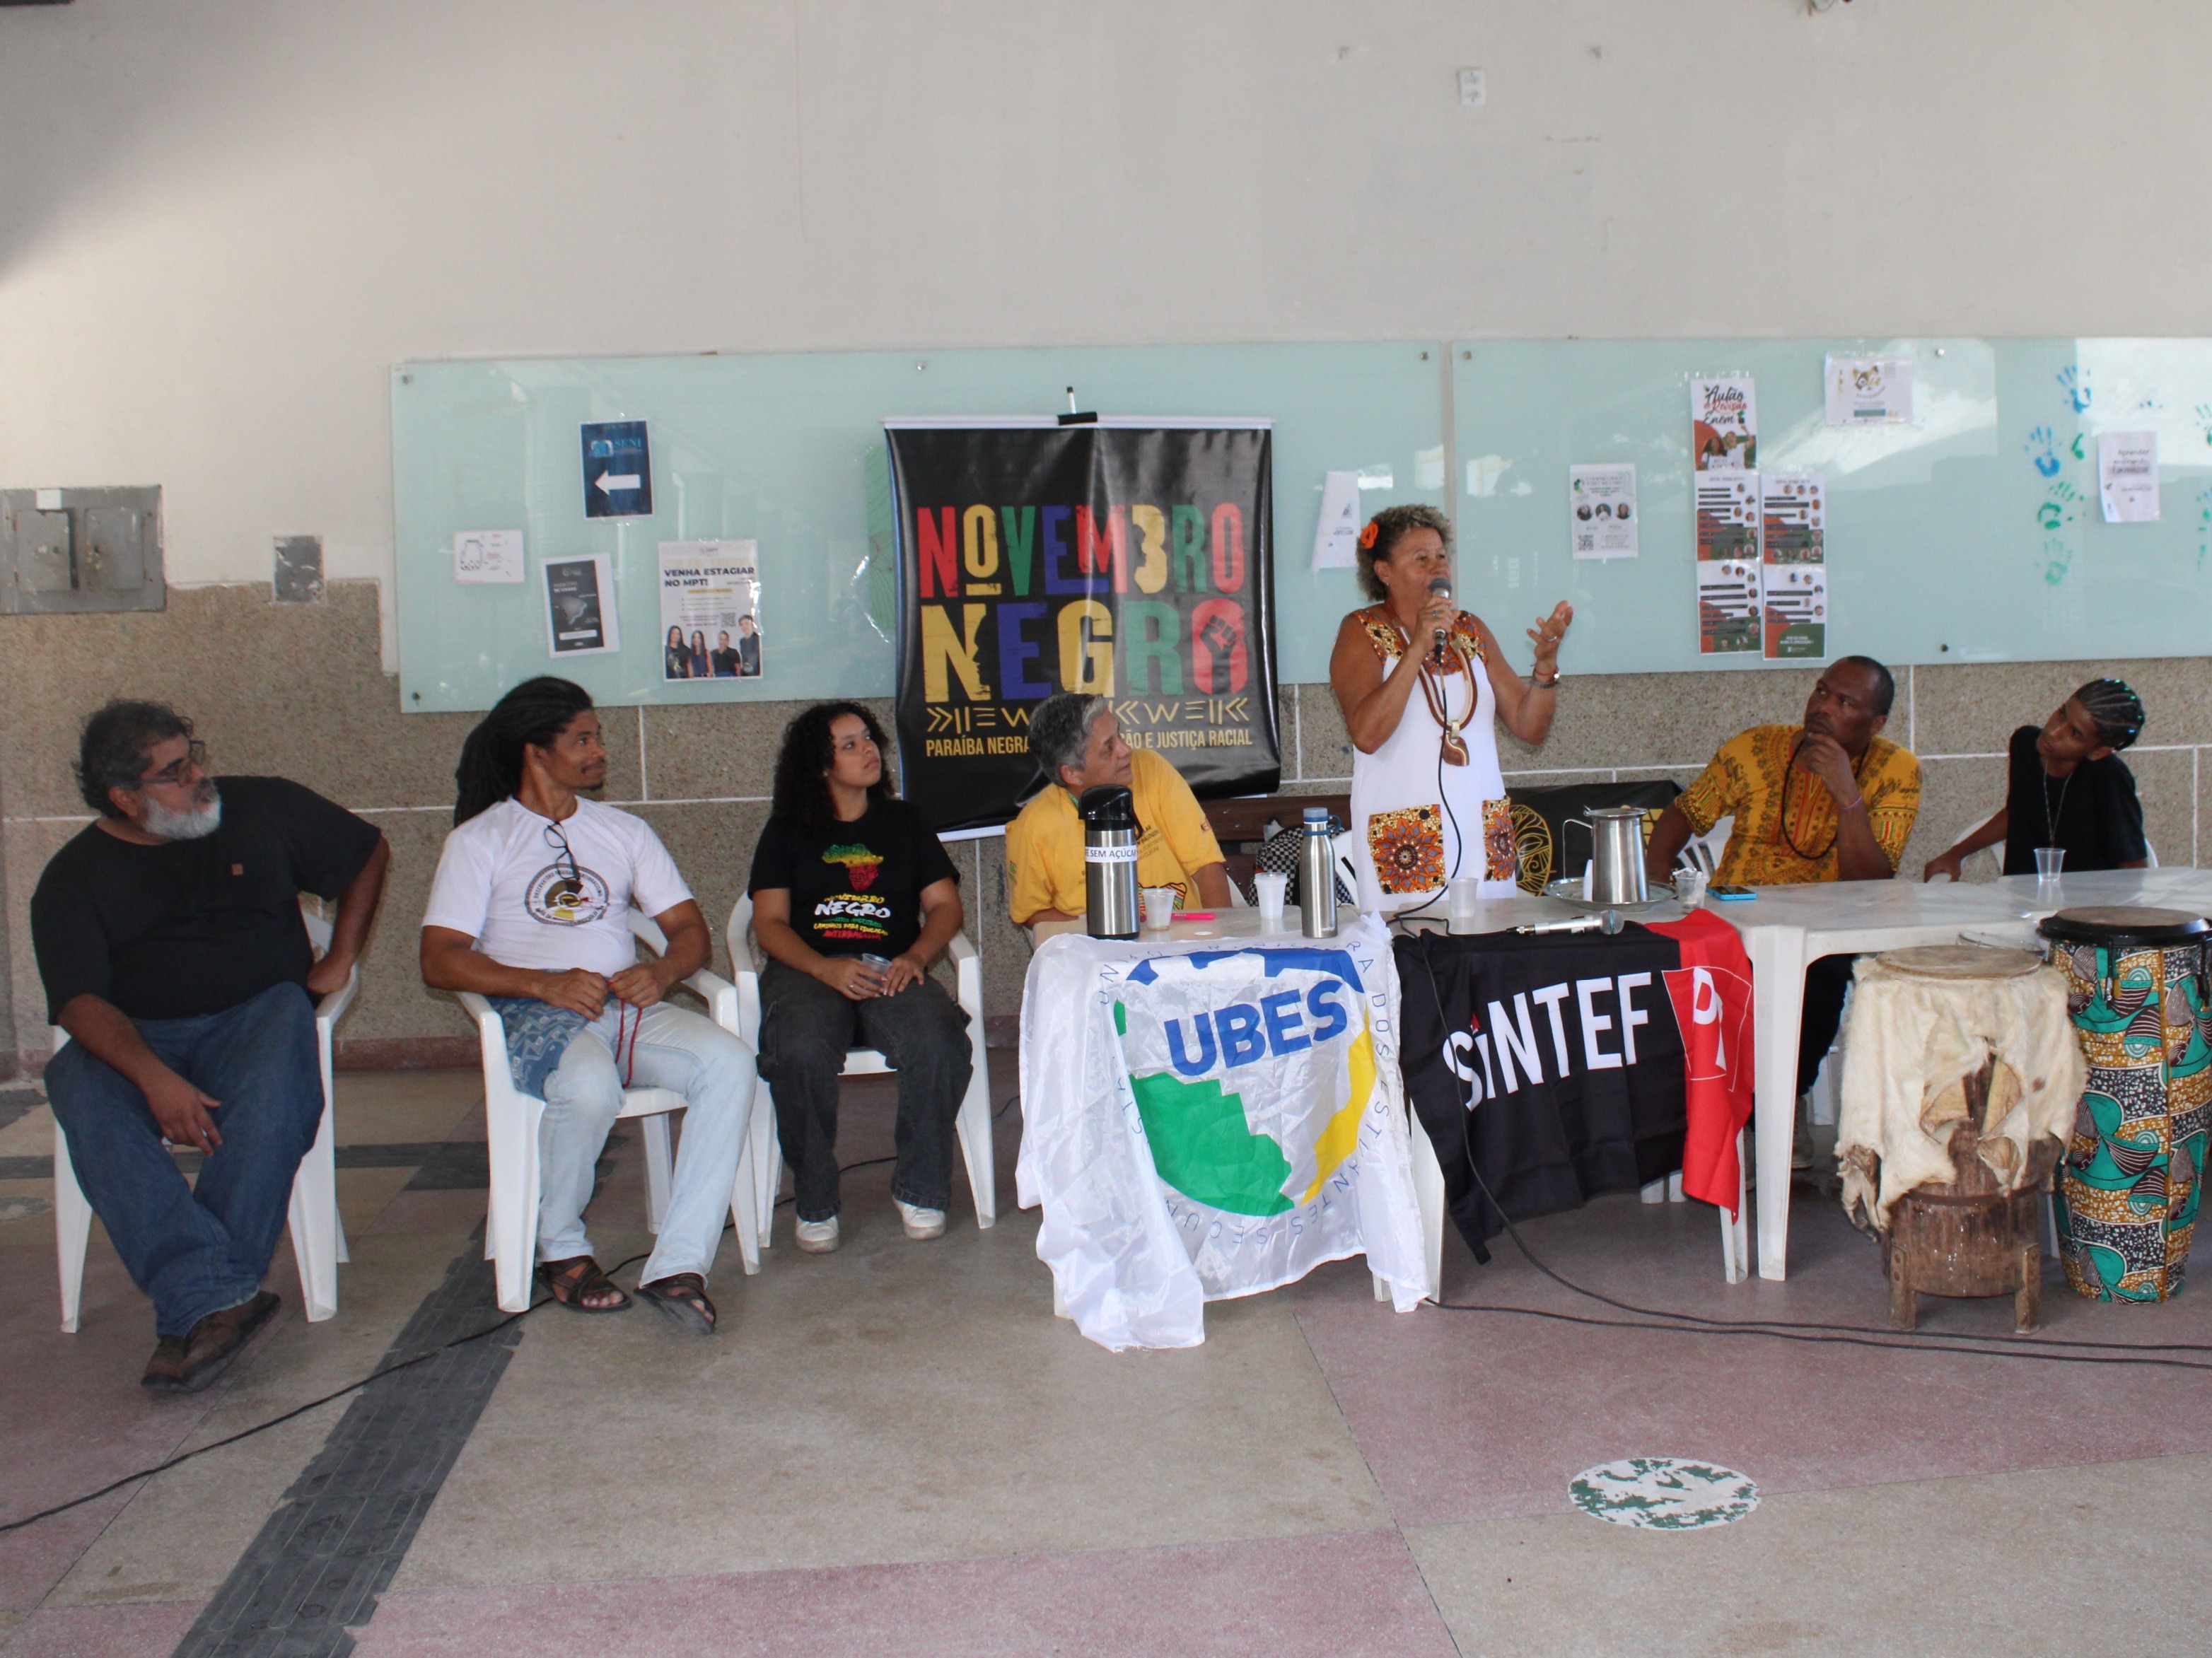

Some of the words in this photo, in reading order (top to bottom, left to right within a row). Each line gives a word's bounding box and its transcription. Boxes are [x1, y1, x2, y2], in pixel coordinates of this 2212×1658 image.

[664, 568, 700, 577] VENHA
[704, 567, 755, 576] ESTAGIAR
[921, 598, 1248, 702] NEGRO
[926, 735, 984, 757] PARAÍBA
[1146, 732, 1153, 749] E
[1156, 730, 1206, 750] JUSTIÇA
[1209, 729, 1252, 747] RACIAL
[814, 900, 891, 918] NEGRO
[1164, 980, 1348, 1076] UBES
